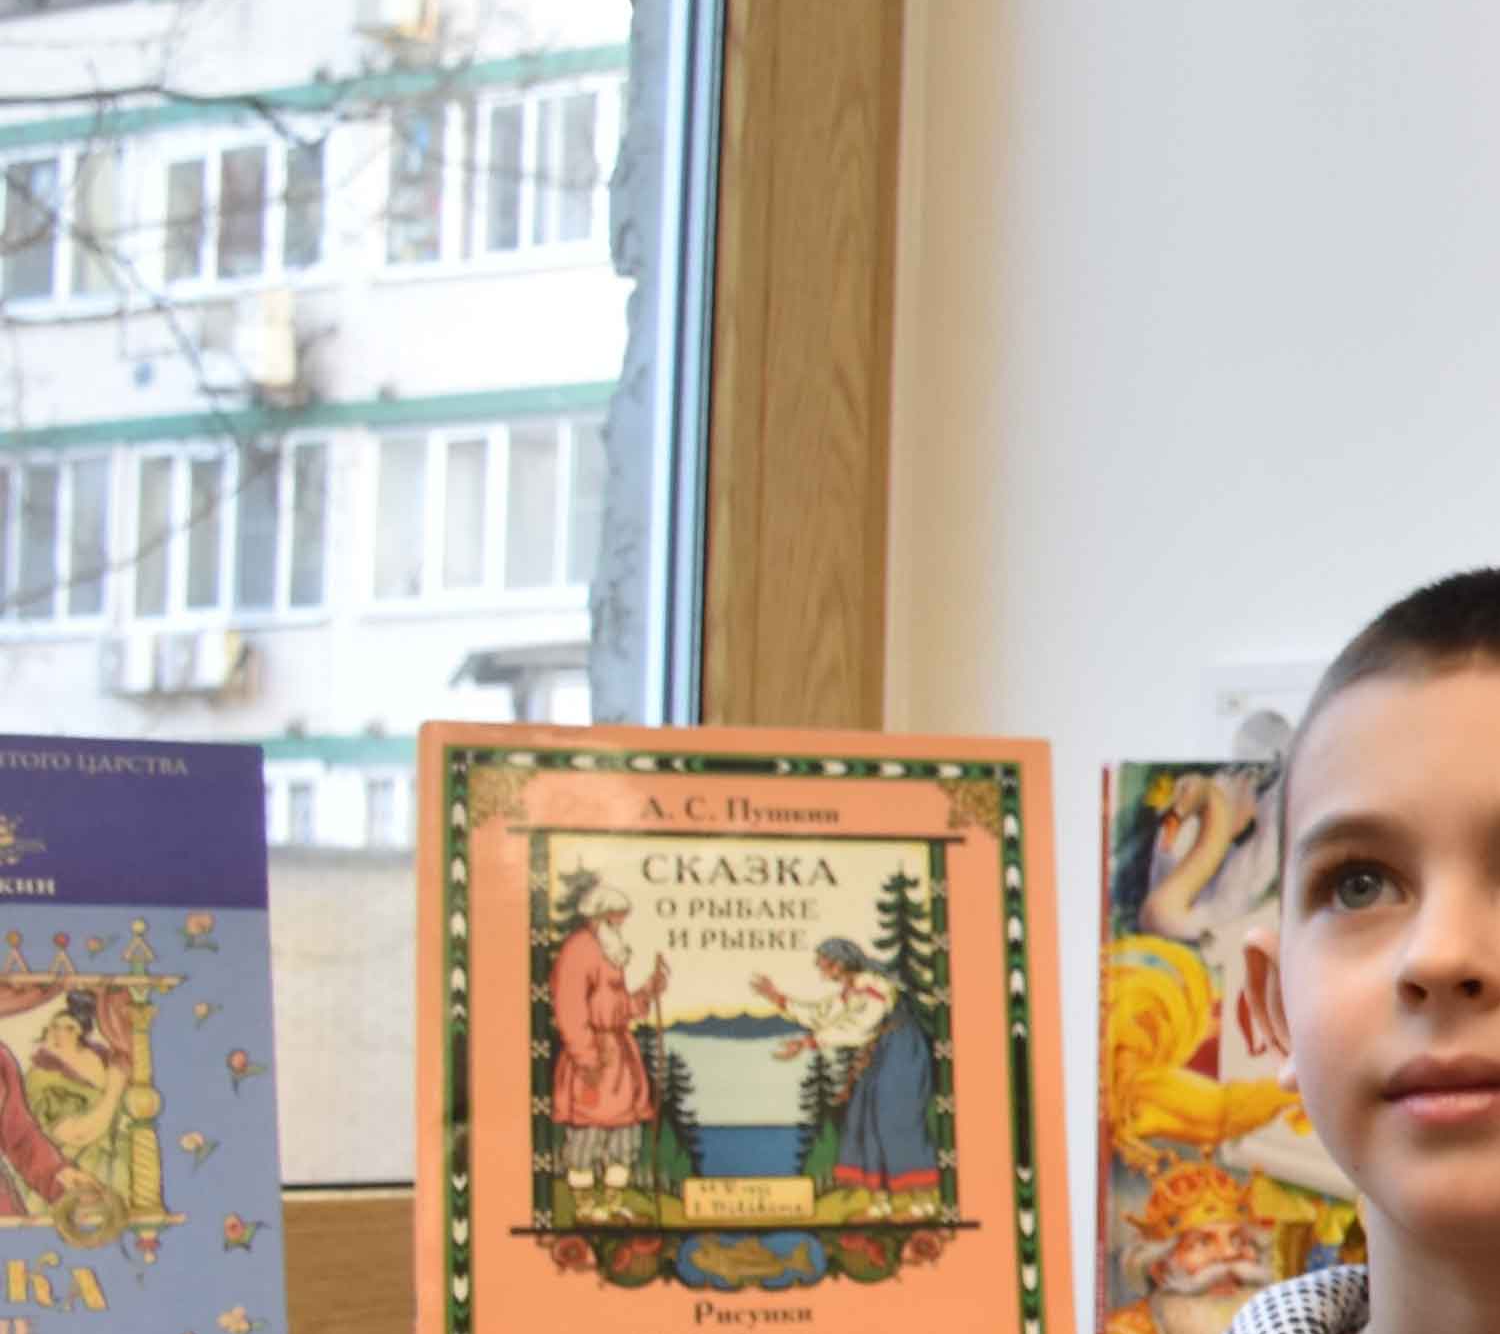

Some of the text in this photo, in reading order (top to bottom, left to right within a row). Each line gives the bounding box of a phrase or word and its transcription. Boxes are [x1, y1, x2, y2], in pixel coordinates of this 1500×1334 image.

[0, 753, 190, 778] ТОГО ЦАРСТВА
[725, 796, 840, 827] Пушкин
[641, 852, 839, 887] СКАЗКА
[656, 897, 820, 920] О РЫБАКЕ
[668, 927, 808, 951] И РЫБКЕ
[693, 1299, 813, 1329] Рисунки
